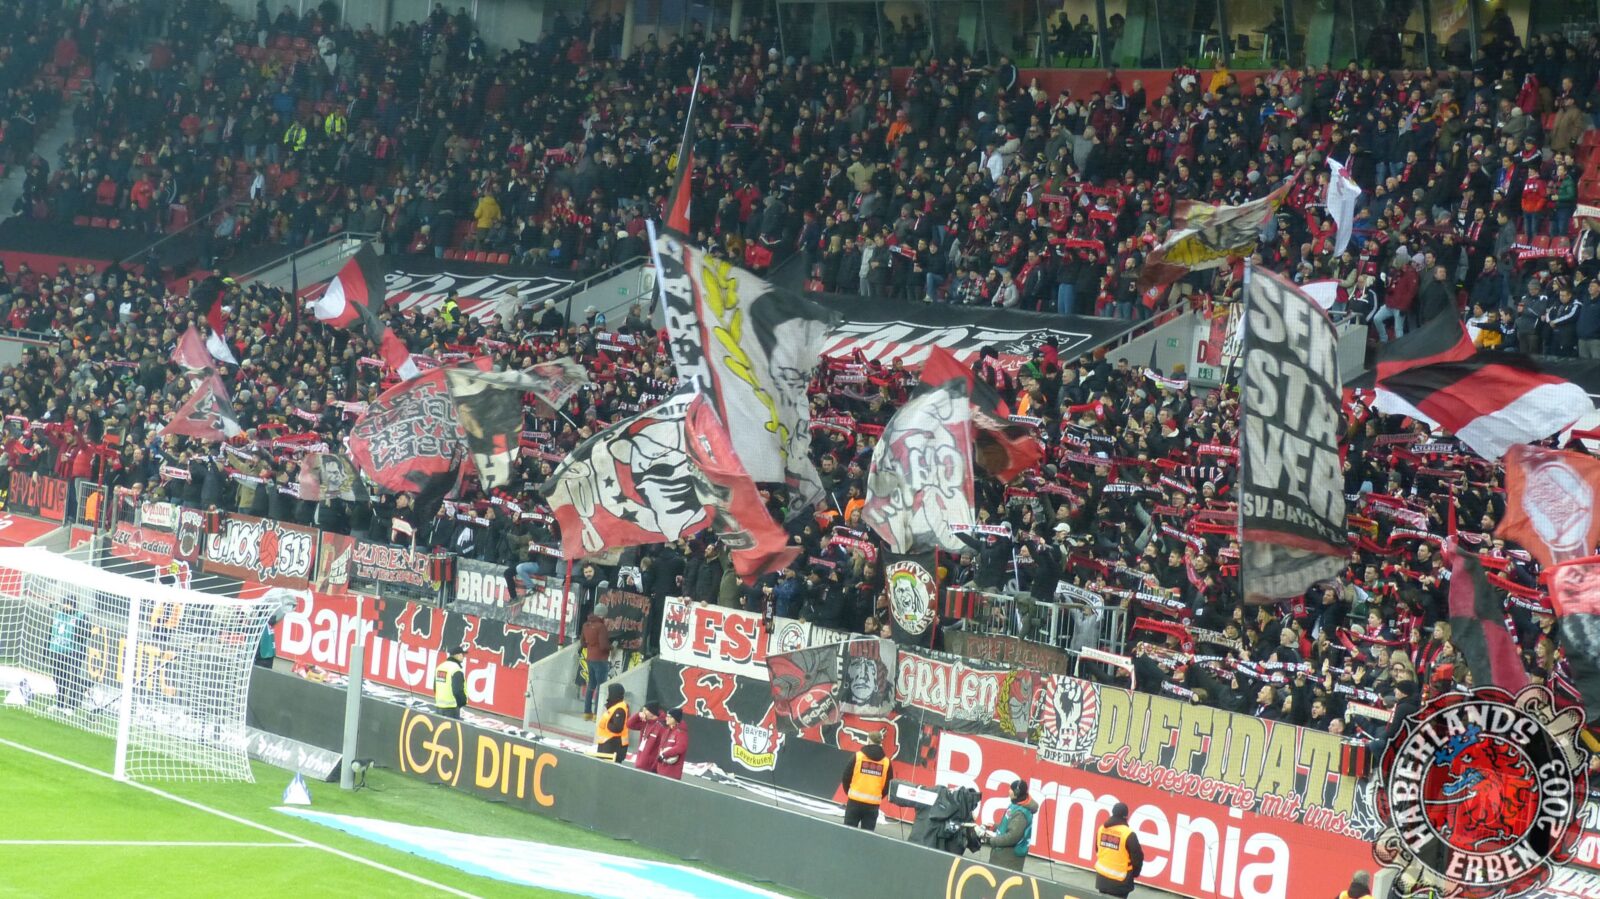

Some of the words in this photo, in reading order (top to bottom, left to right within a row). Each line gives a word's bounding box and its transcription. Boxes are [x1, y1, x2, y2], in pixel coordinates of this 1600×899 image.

[1246, 348, 1339, 448] STA
[1246, 415, 1346, 528] VER
[1244, 494, 1268, 517] SV
[278, 530, 314, 578] 513
[352, 542, 431, 573] JUGEND
[745, 726, 768, 740] BAYER
[475, 734, 558, 807] DITC
[736, 748, 773, 767] Leverkusen
[1097, 746, 1256, 811] Ausgesperrte
[1260, 790, 1300, 825] mit
